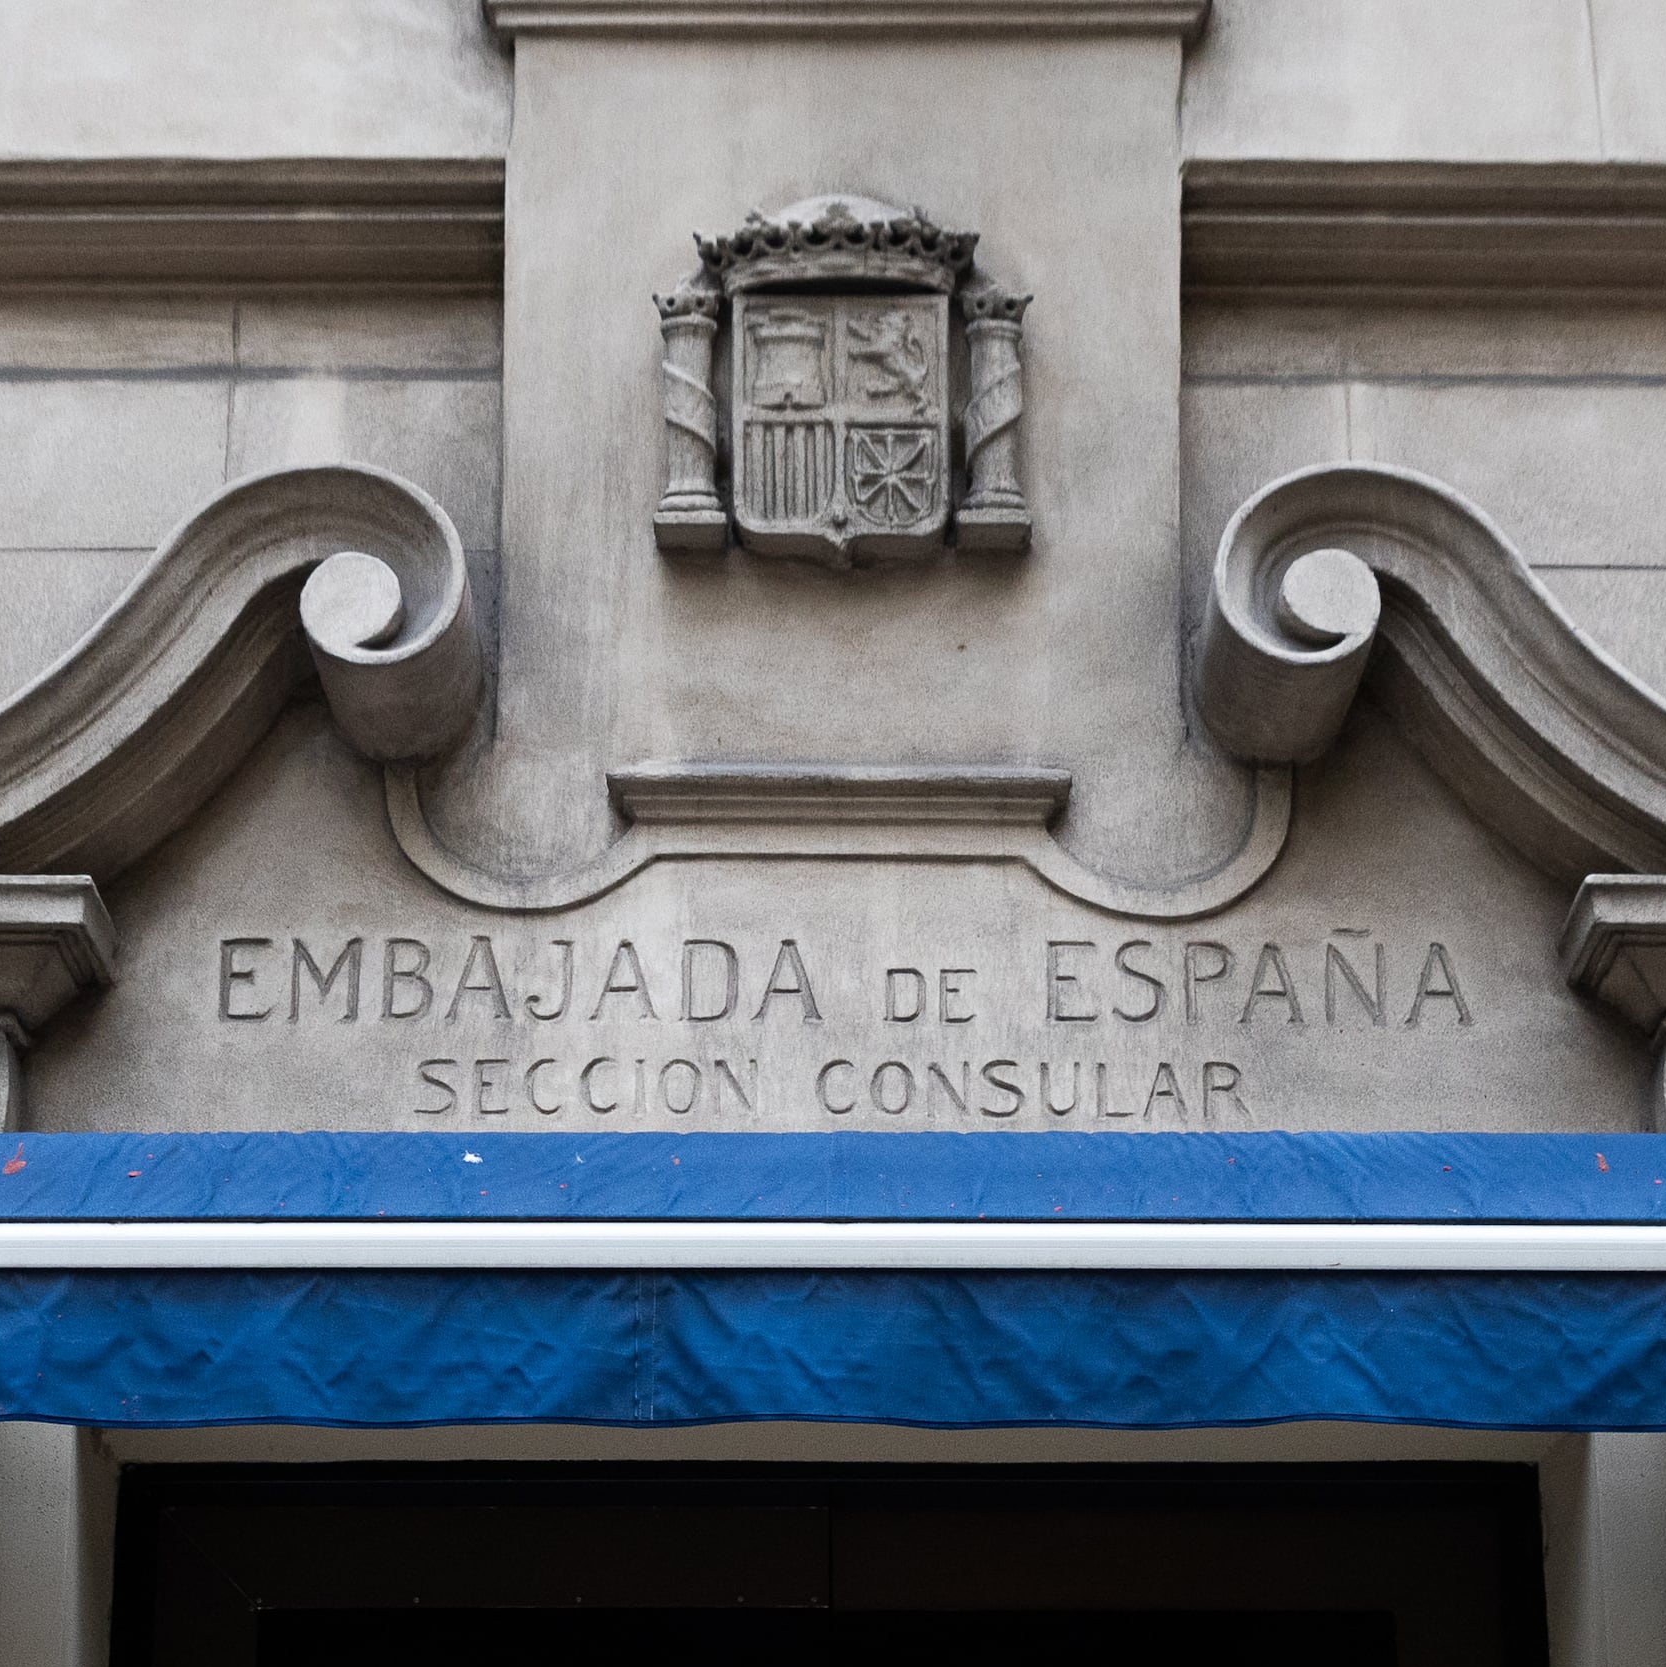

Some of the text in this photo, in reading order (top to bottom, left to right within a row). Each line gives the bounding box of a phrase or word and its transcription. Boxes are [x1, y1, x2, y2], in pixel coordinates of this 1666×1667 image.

[218, 927, 1473, 1027] EMBAJADA DE ESPAÑA
[413, 1057, 1252, 1121] SECCION CONSULAR
